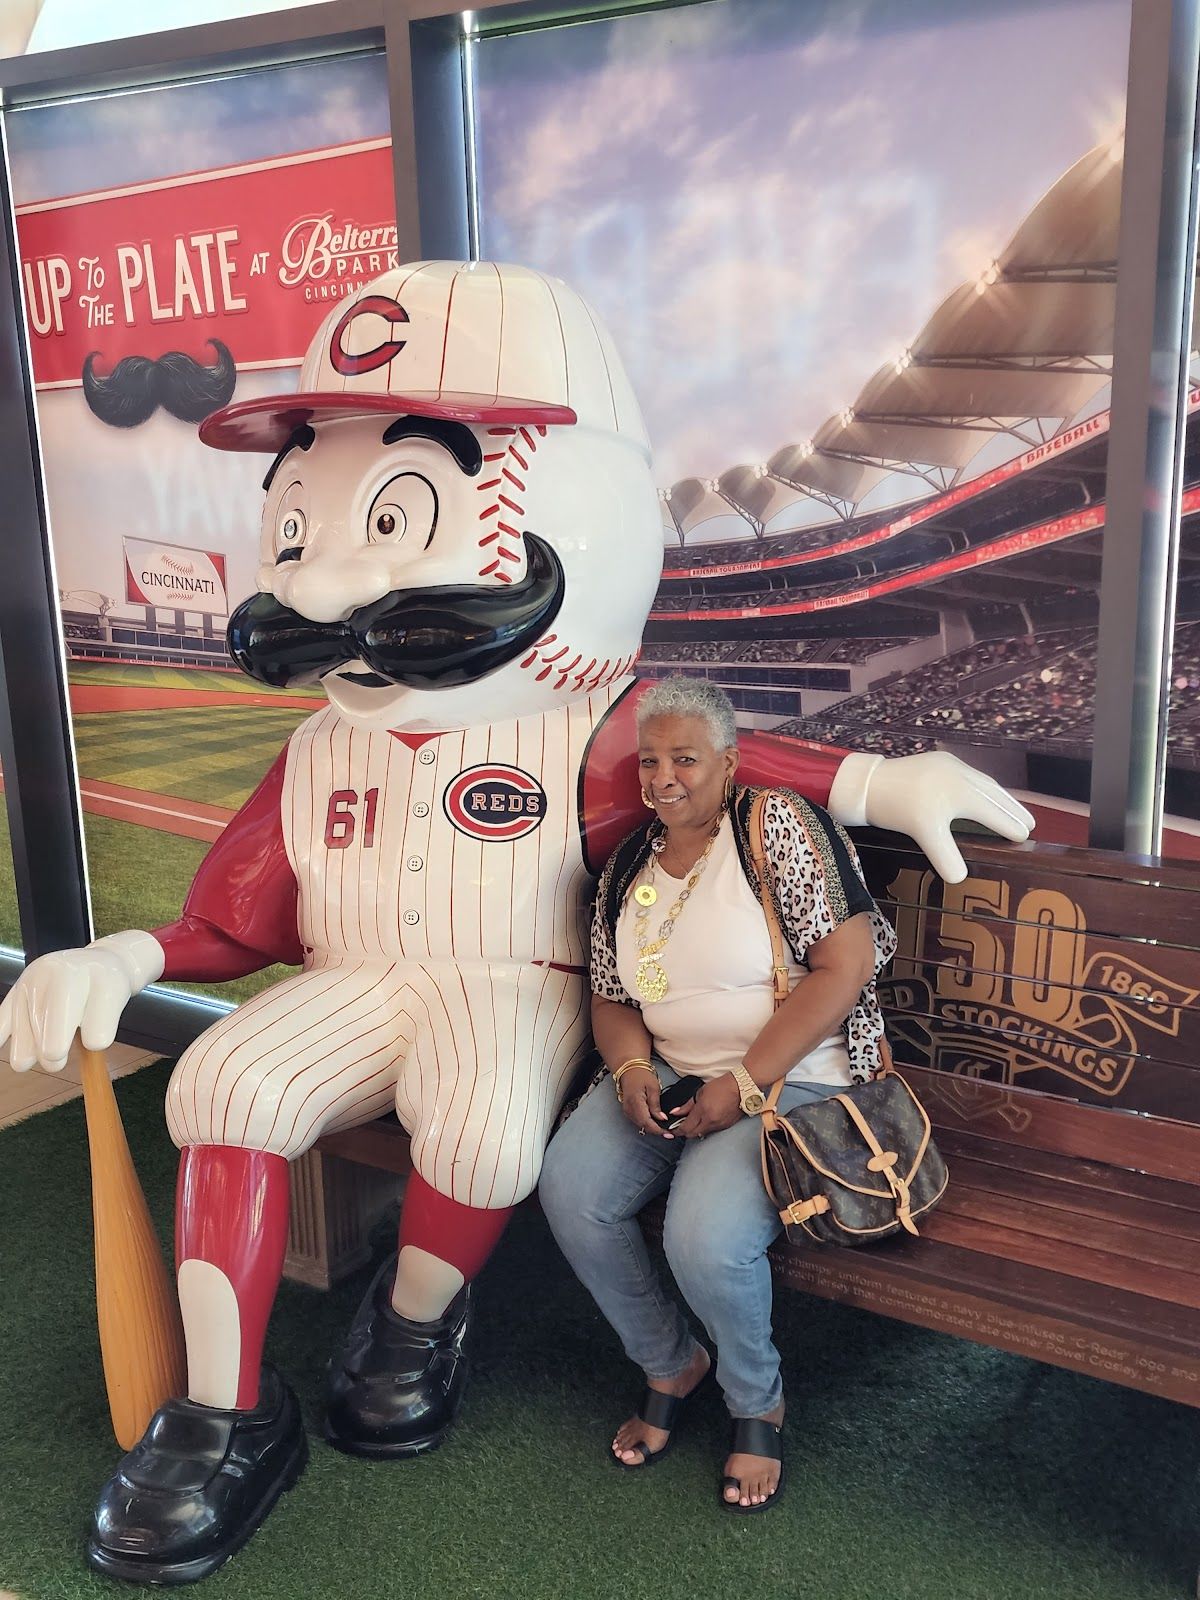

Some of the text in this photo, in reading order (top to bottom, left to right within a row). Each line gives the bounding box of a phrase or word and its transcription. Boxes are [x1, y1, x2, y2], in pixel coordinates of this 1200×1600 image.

[24, 258, 72, 334] UP
[79, 295, 114, 328] THE
[117, 230, 247, 323] PLATE
[250, 252, 270, 276] AT
[336, 251, 399, 277] PARK
[329, 295, 410, 377] C
[1026, 419, 1101, 464] BASEBALL
[141, 571, 215, 595] CINCINNATI
[324, 787, 379, 850] 61
[471, 792, 540, 813] REDS
[886, 867, 1088, 1025] 150
[1101, 965, 1171, 1014] 1869
[876, 985, 1118, 1083] ED STOCKINGS
[837, 1271, 882, 1289] uniform
[886, 1285, 937, 1305] featured
[940, 1301, 948, 1309] a
[952, 1305, 981, 1319] navy
[1134, 1355, 1166, 1372] logo
[879, 1295, 973, 1327] commemorated
[1002, 1331, 1041, 1347] owner
[1045, 1342, 1086, 1360] Powel
